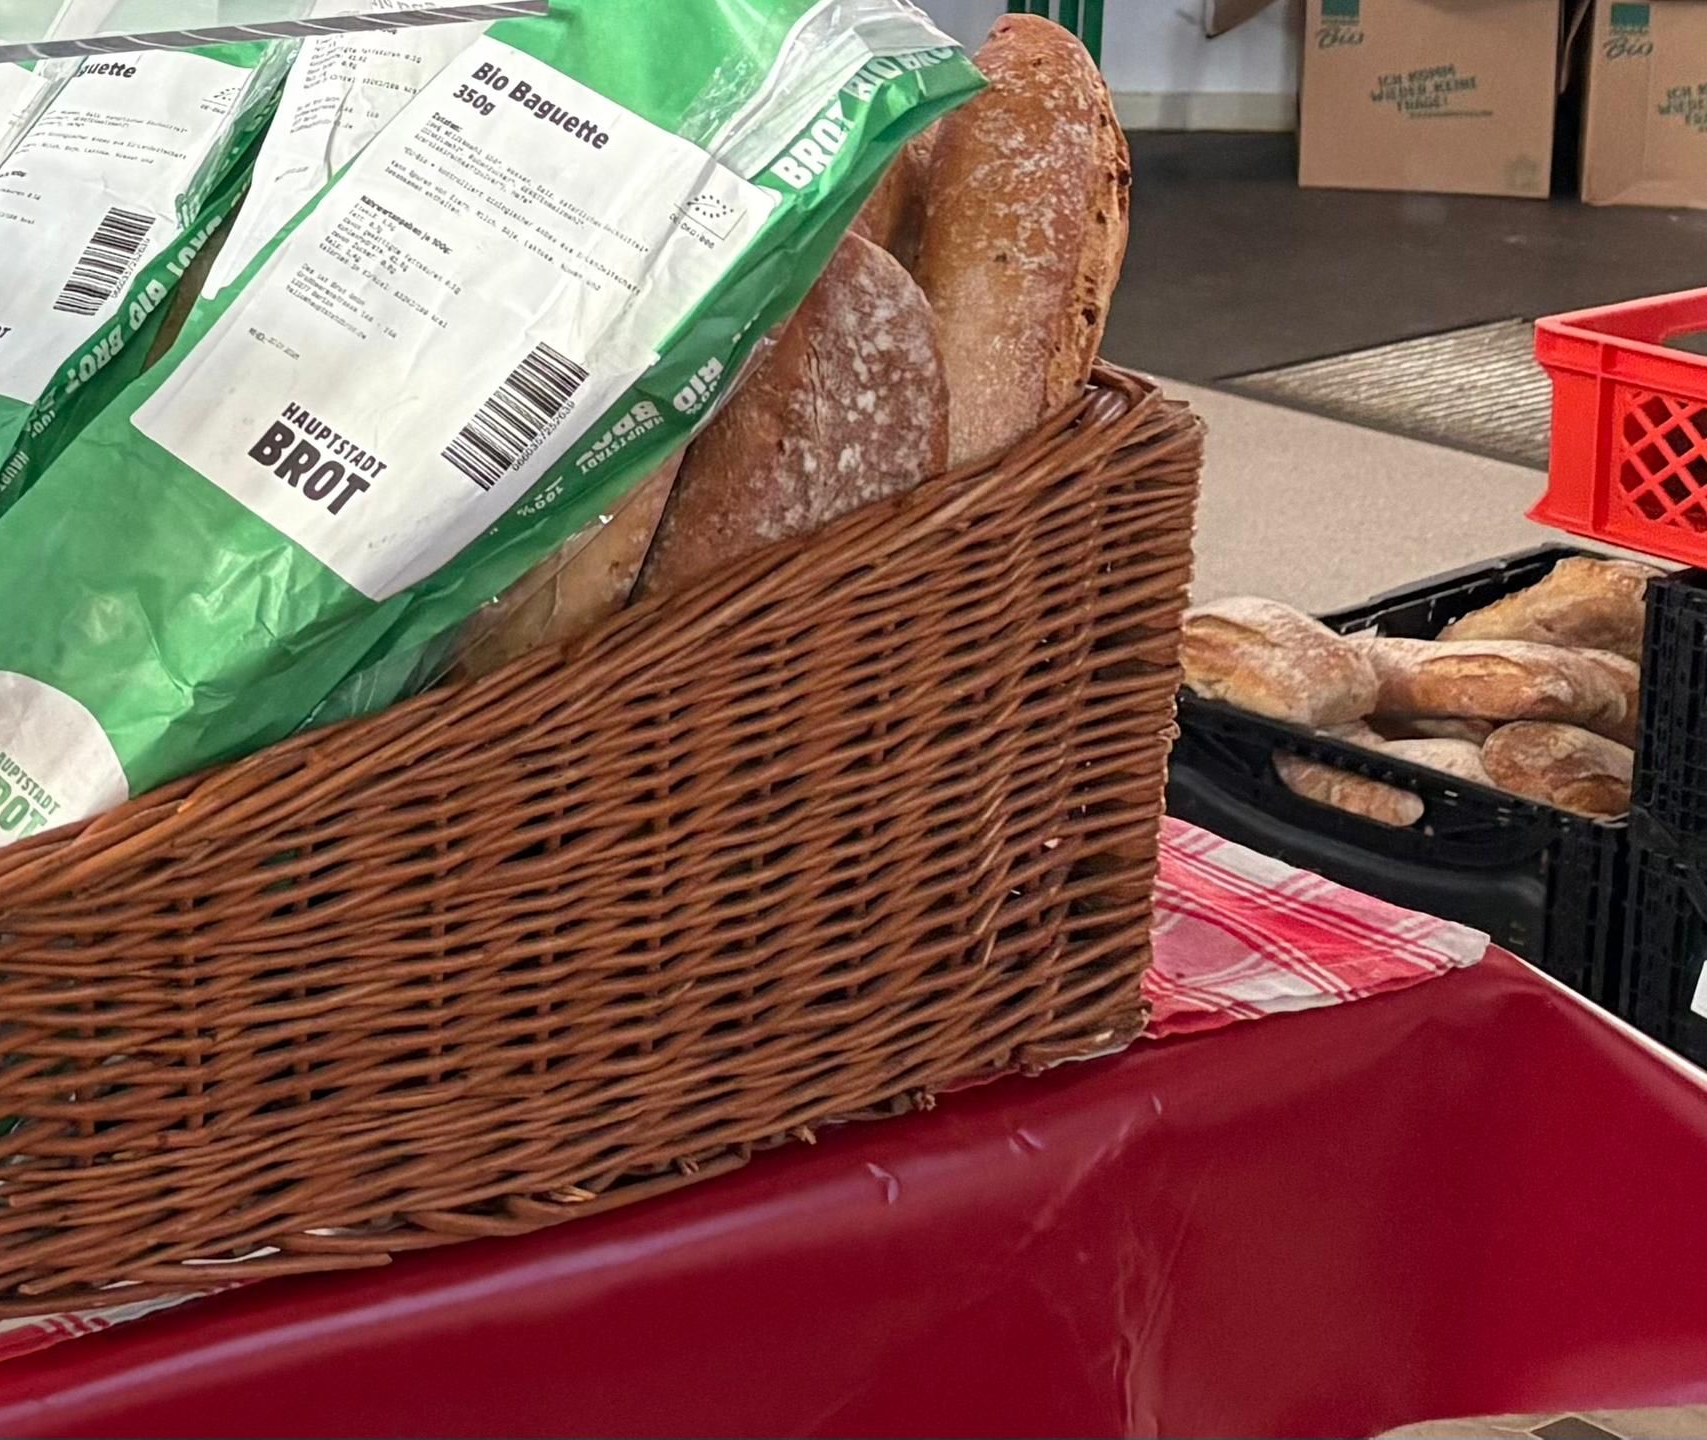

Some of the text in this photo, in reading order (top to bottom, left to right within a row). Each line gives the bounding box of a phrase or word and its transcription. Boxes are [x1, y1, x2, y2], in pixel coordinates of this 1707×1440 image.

[1317, 26, 1365, 50] Bio
[1603, 36, 1654, 60] Bio
[450, 83, 498, 117] 350g
[471, 60, 514, 93] Bio
[504, 80, 614, 153] Baguette
[129, 278, 168, 331] BIO
[279, 401, 387, 480] HAUPTSTADT
[581, 417, 665, 475] HAUPTSTADT
[245, 420, 370, 518] BROT
